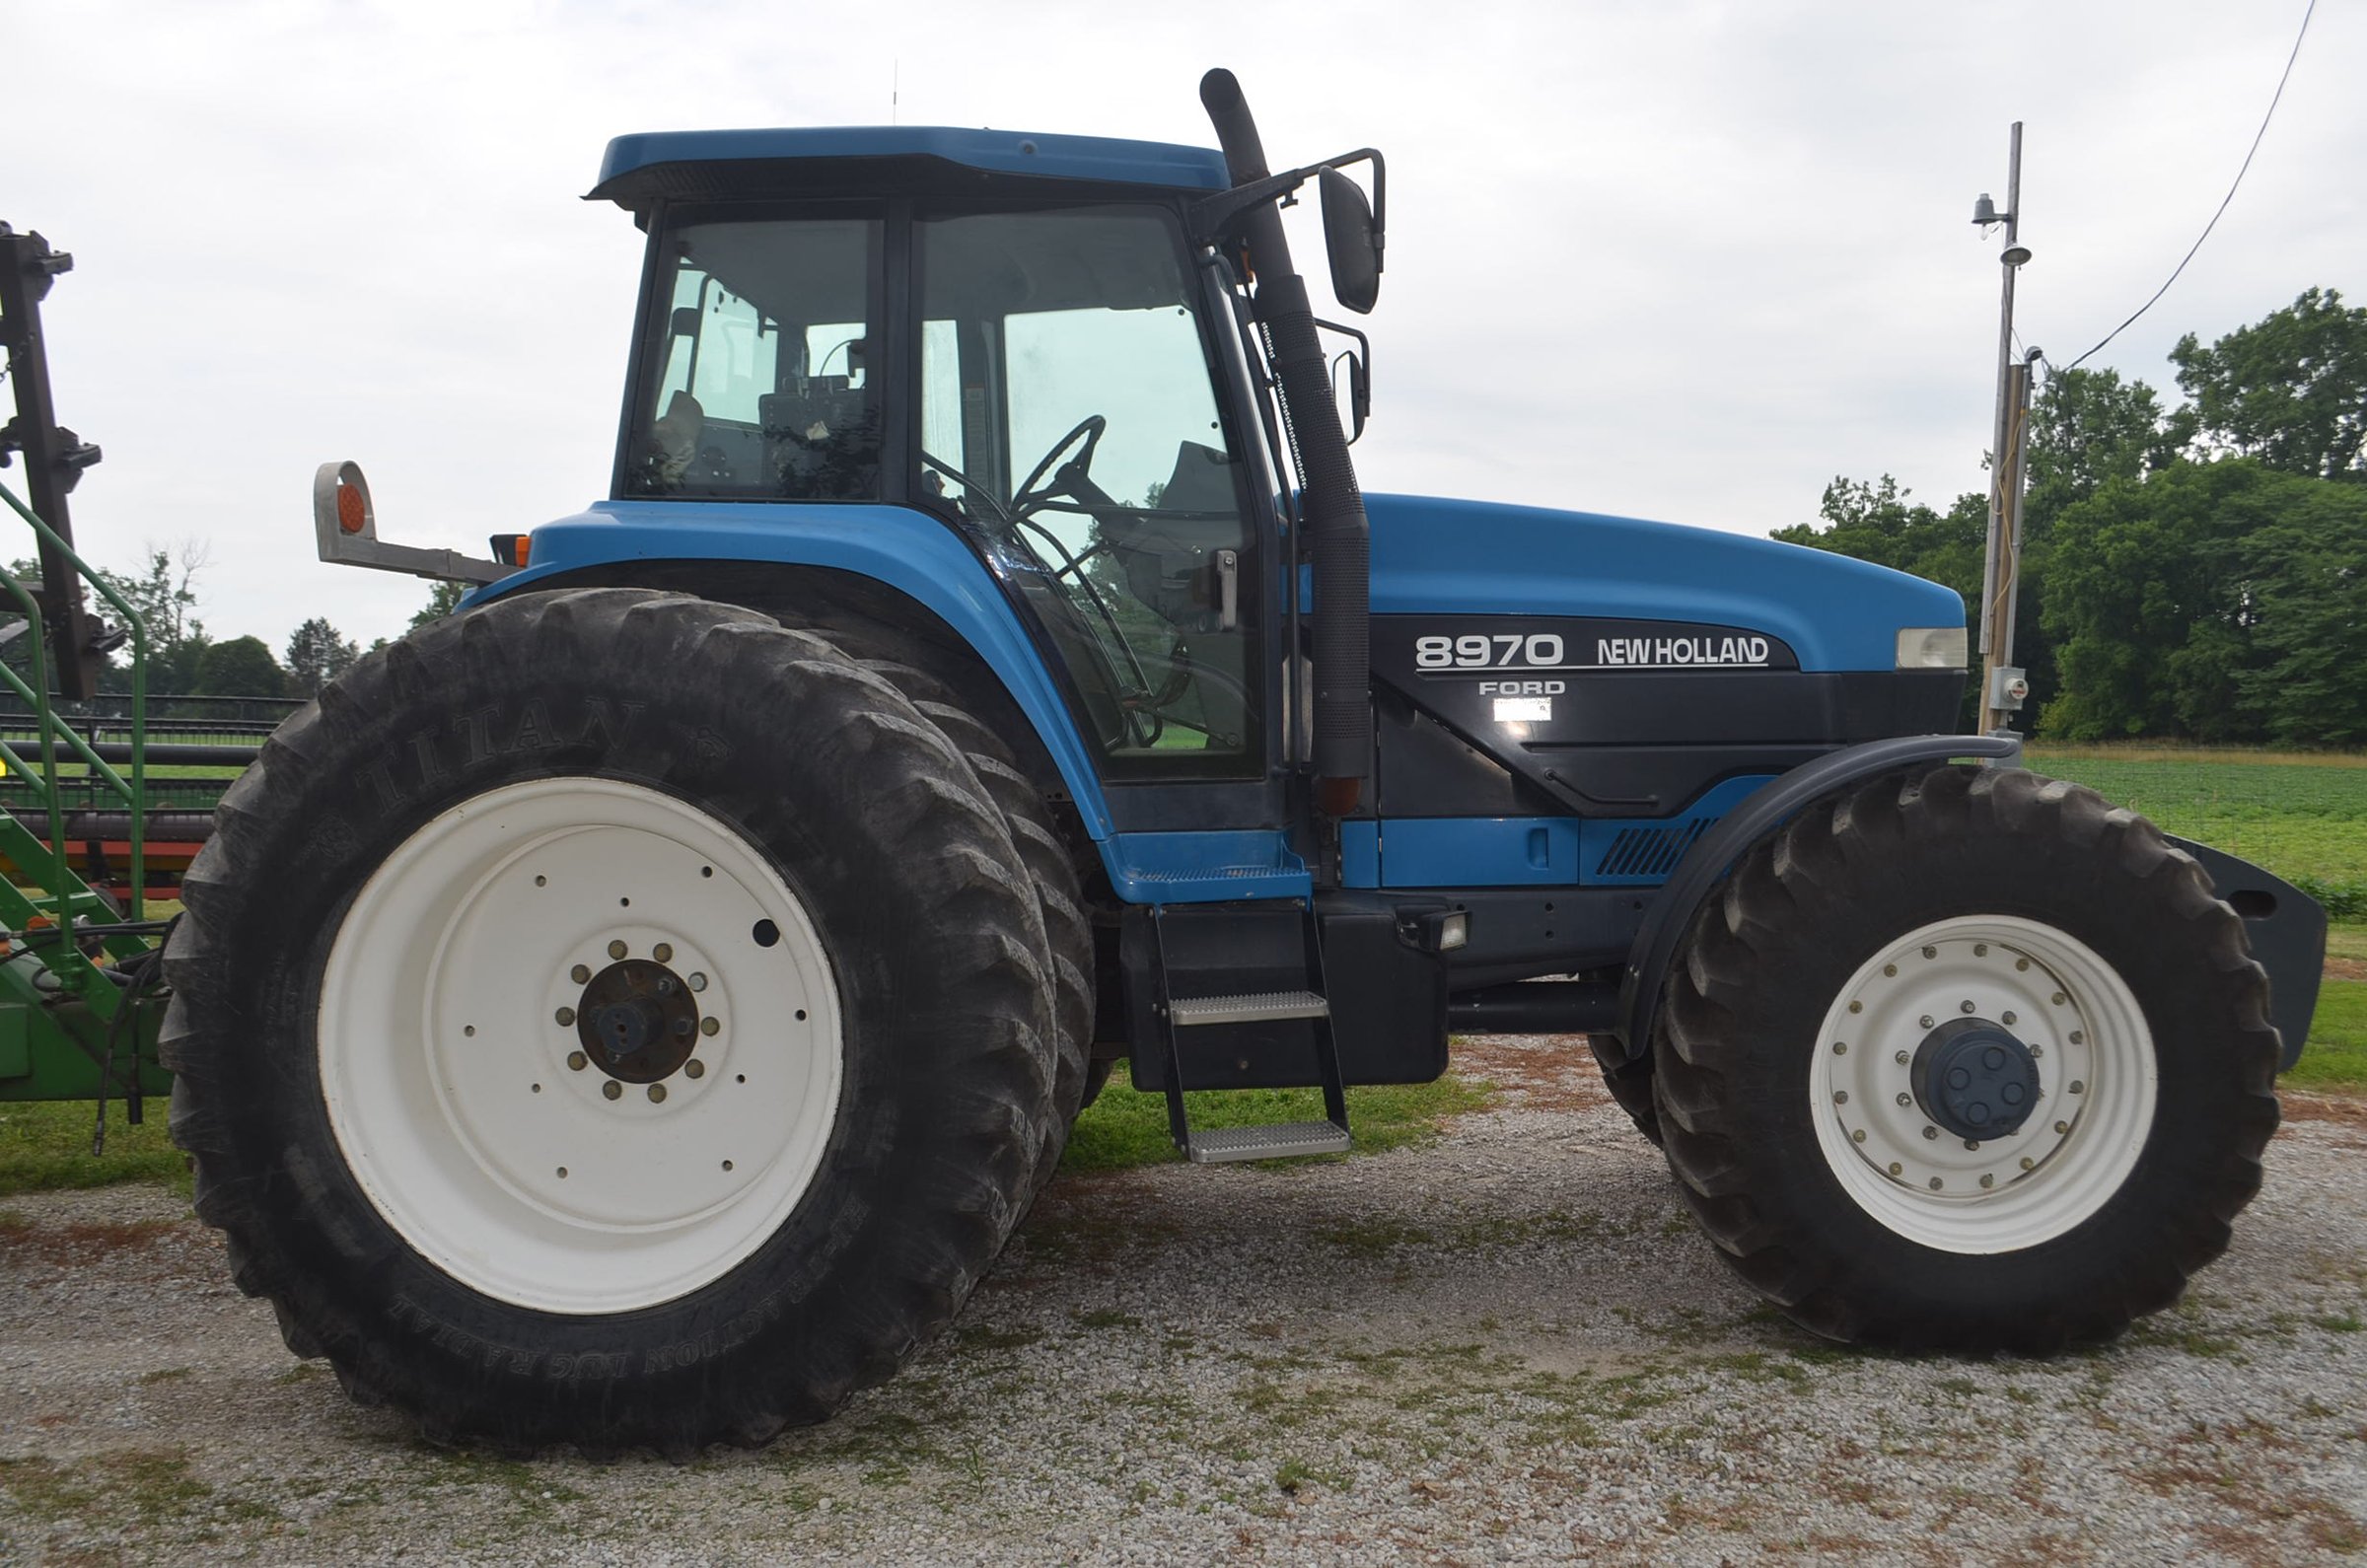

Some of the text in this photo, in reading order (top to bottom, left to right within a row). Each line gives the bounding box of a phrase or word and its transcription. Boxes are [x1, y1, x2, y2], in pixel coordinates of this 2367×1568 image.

[1415, 634, 1564, 668] 8970
[1598, 637, 1769, 665] NEW HOLLAND
[1478, 680, 1566, 696] FORD
[354, 696, 646, 818] TITAN
[387, 1294, 546, 1376] RADIAL
